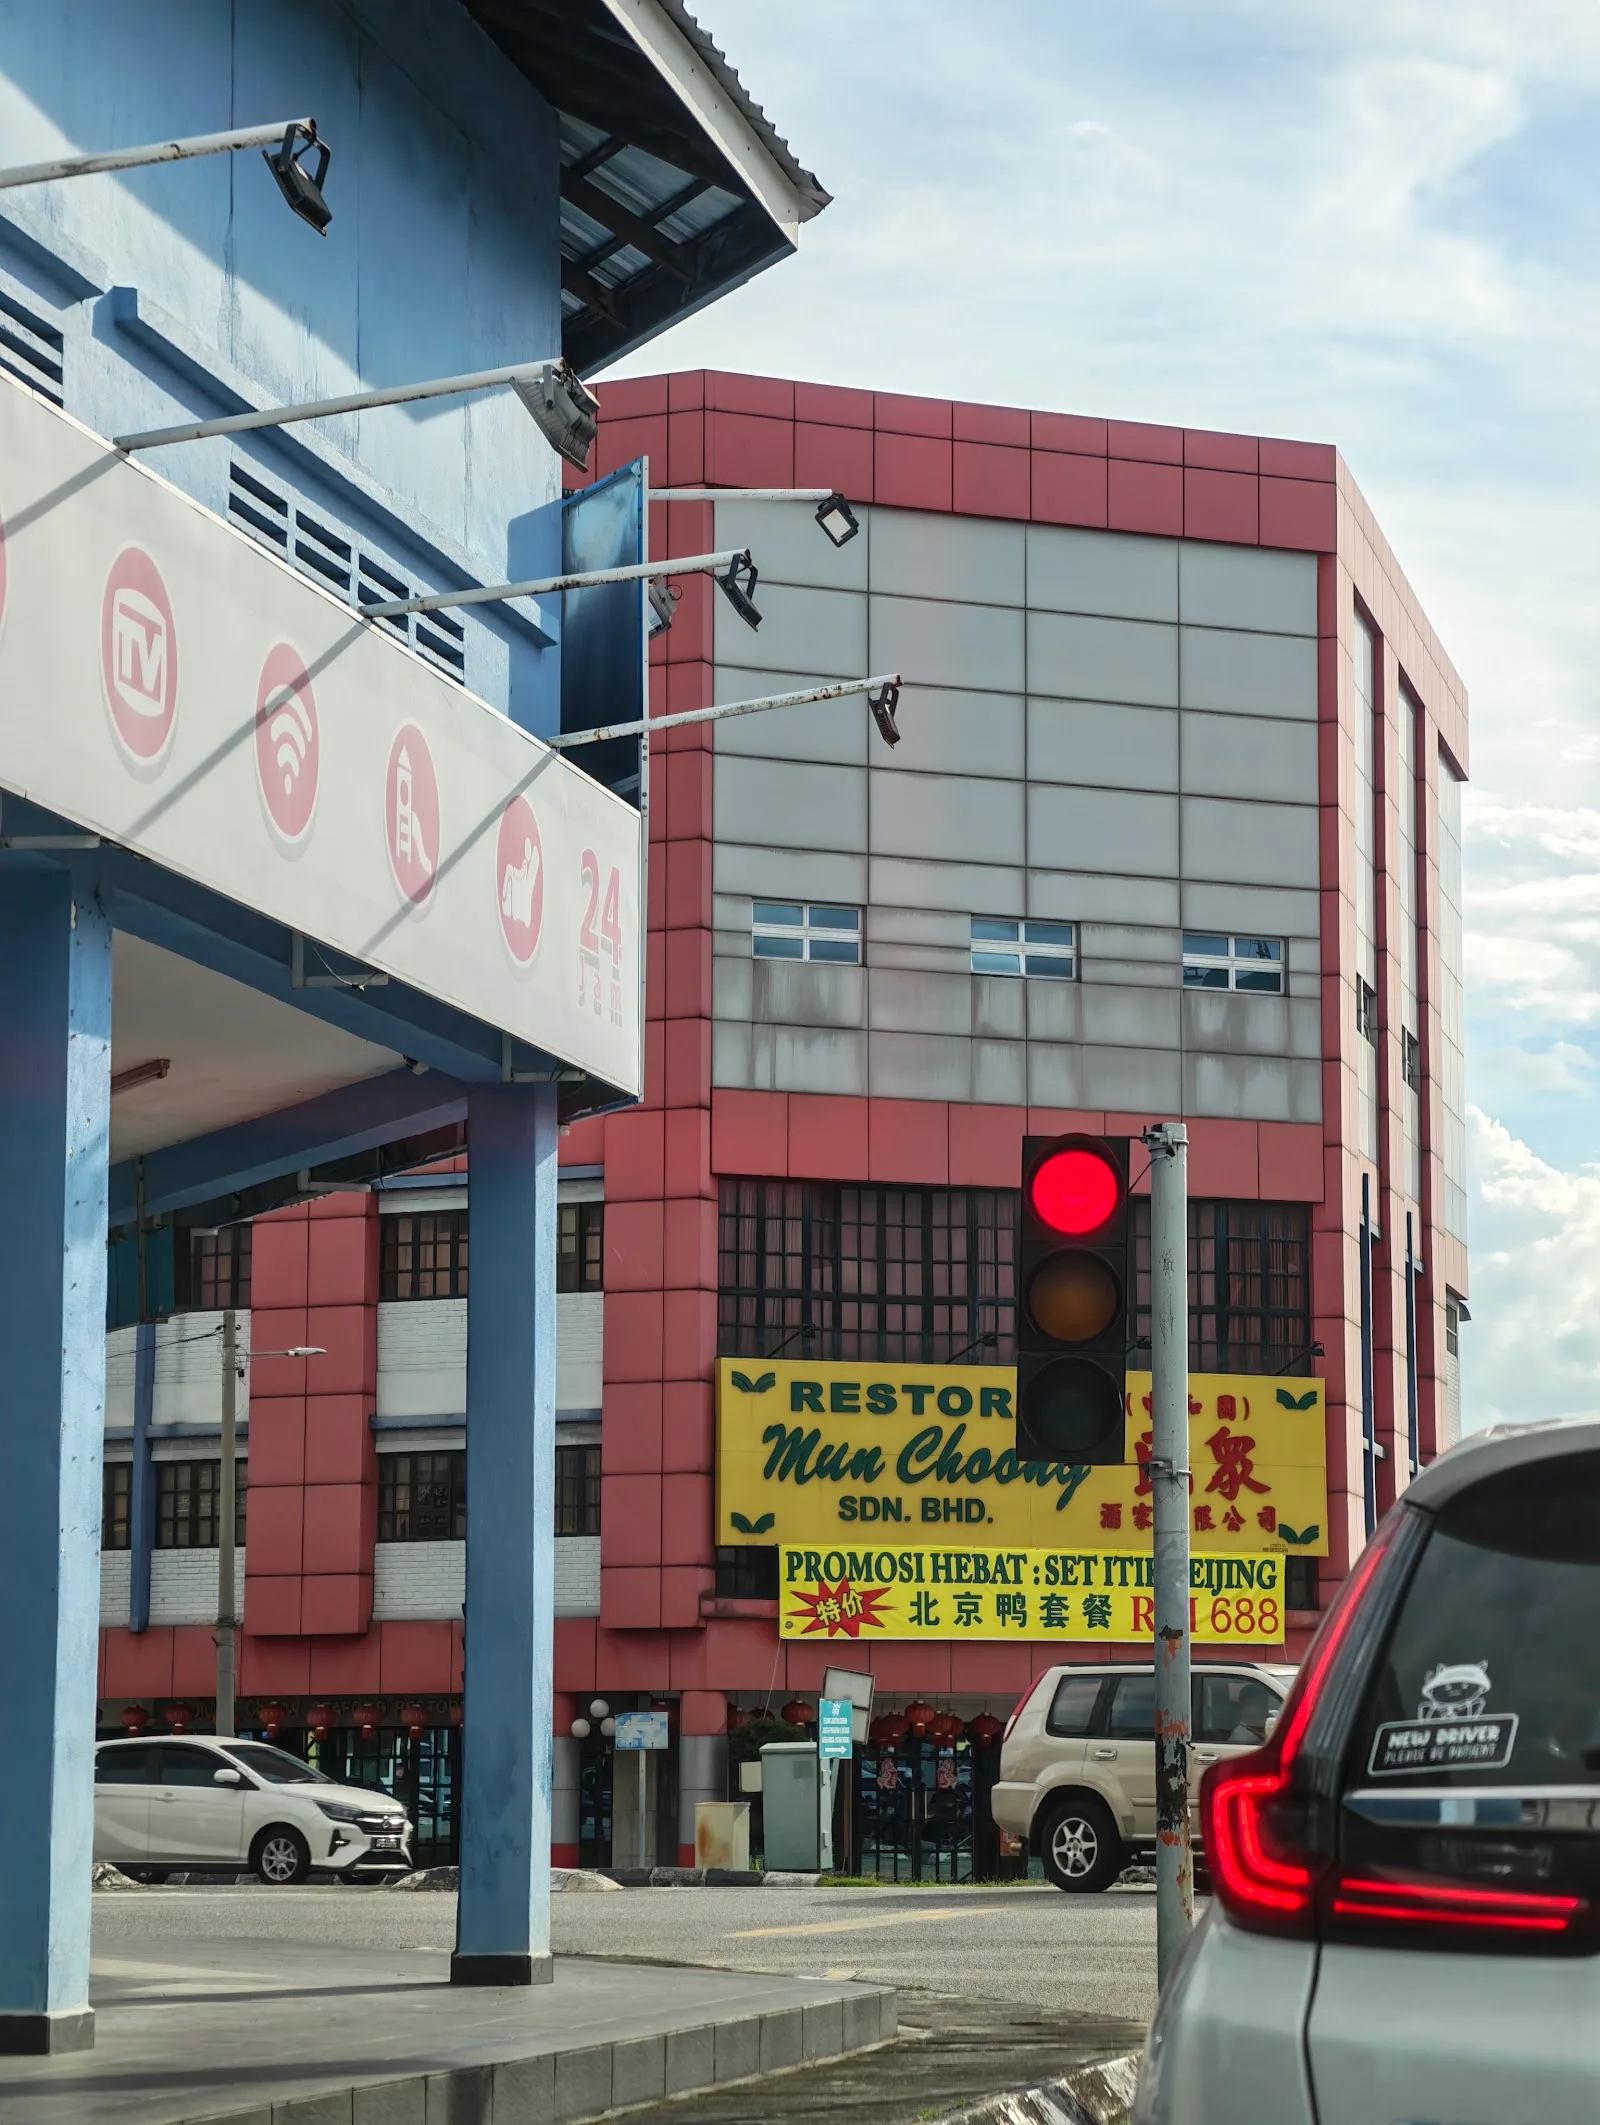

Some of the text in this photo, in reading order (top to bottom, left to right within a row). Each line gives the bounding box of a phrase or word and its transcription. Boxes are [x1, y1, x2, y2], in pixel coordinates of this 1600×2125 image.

[580, 849, 621, 967] 24
[579, 953, 622, 1013] Jam
[790, 1381, 1016, 1419] RESTOR
[762, 1423, 886, 1485] Mun
[838, 1495, 994, 1523] SDN. BHD.
[1100, 1502, 1277, 1533] 酒家限公司
[785, 1551, 925, 1583] PROMOSI
[1045, 1555, 1098, 1587] SET
[1189, 1559, 1278, 1597] EIJING
[816, 1588, 864, 1627] 特价
[908, 1592, 1113, 1630] 北京鸭套餐
[1210, 1597, 1279, 1635] 688
[1388, 1725, 1500, 1748] NEW DRIVER
